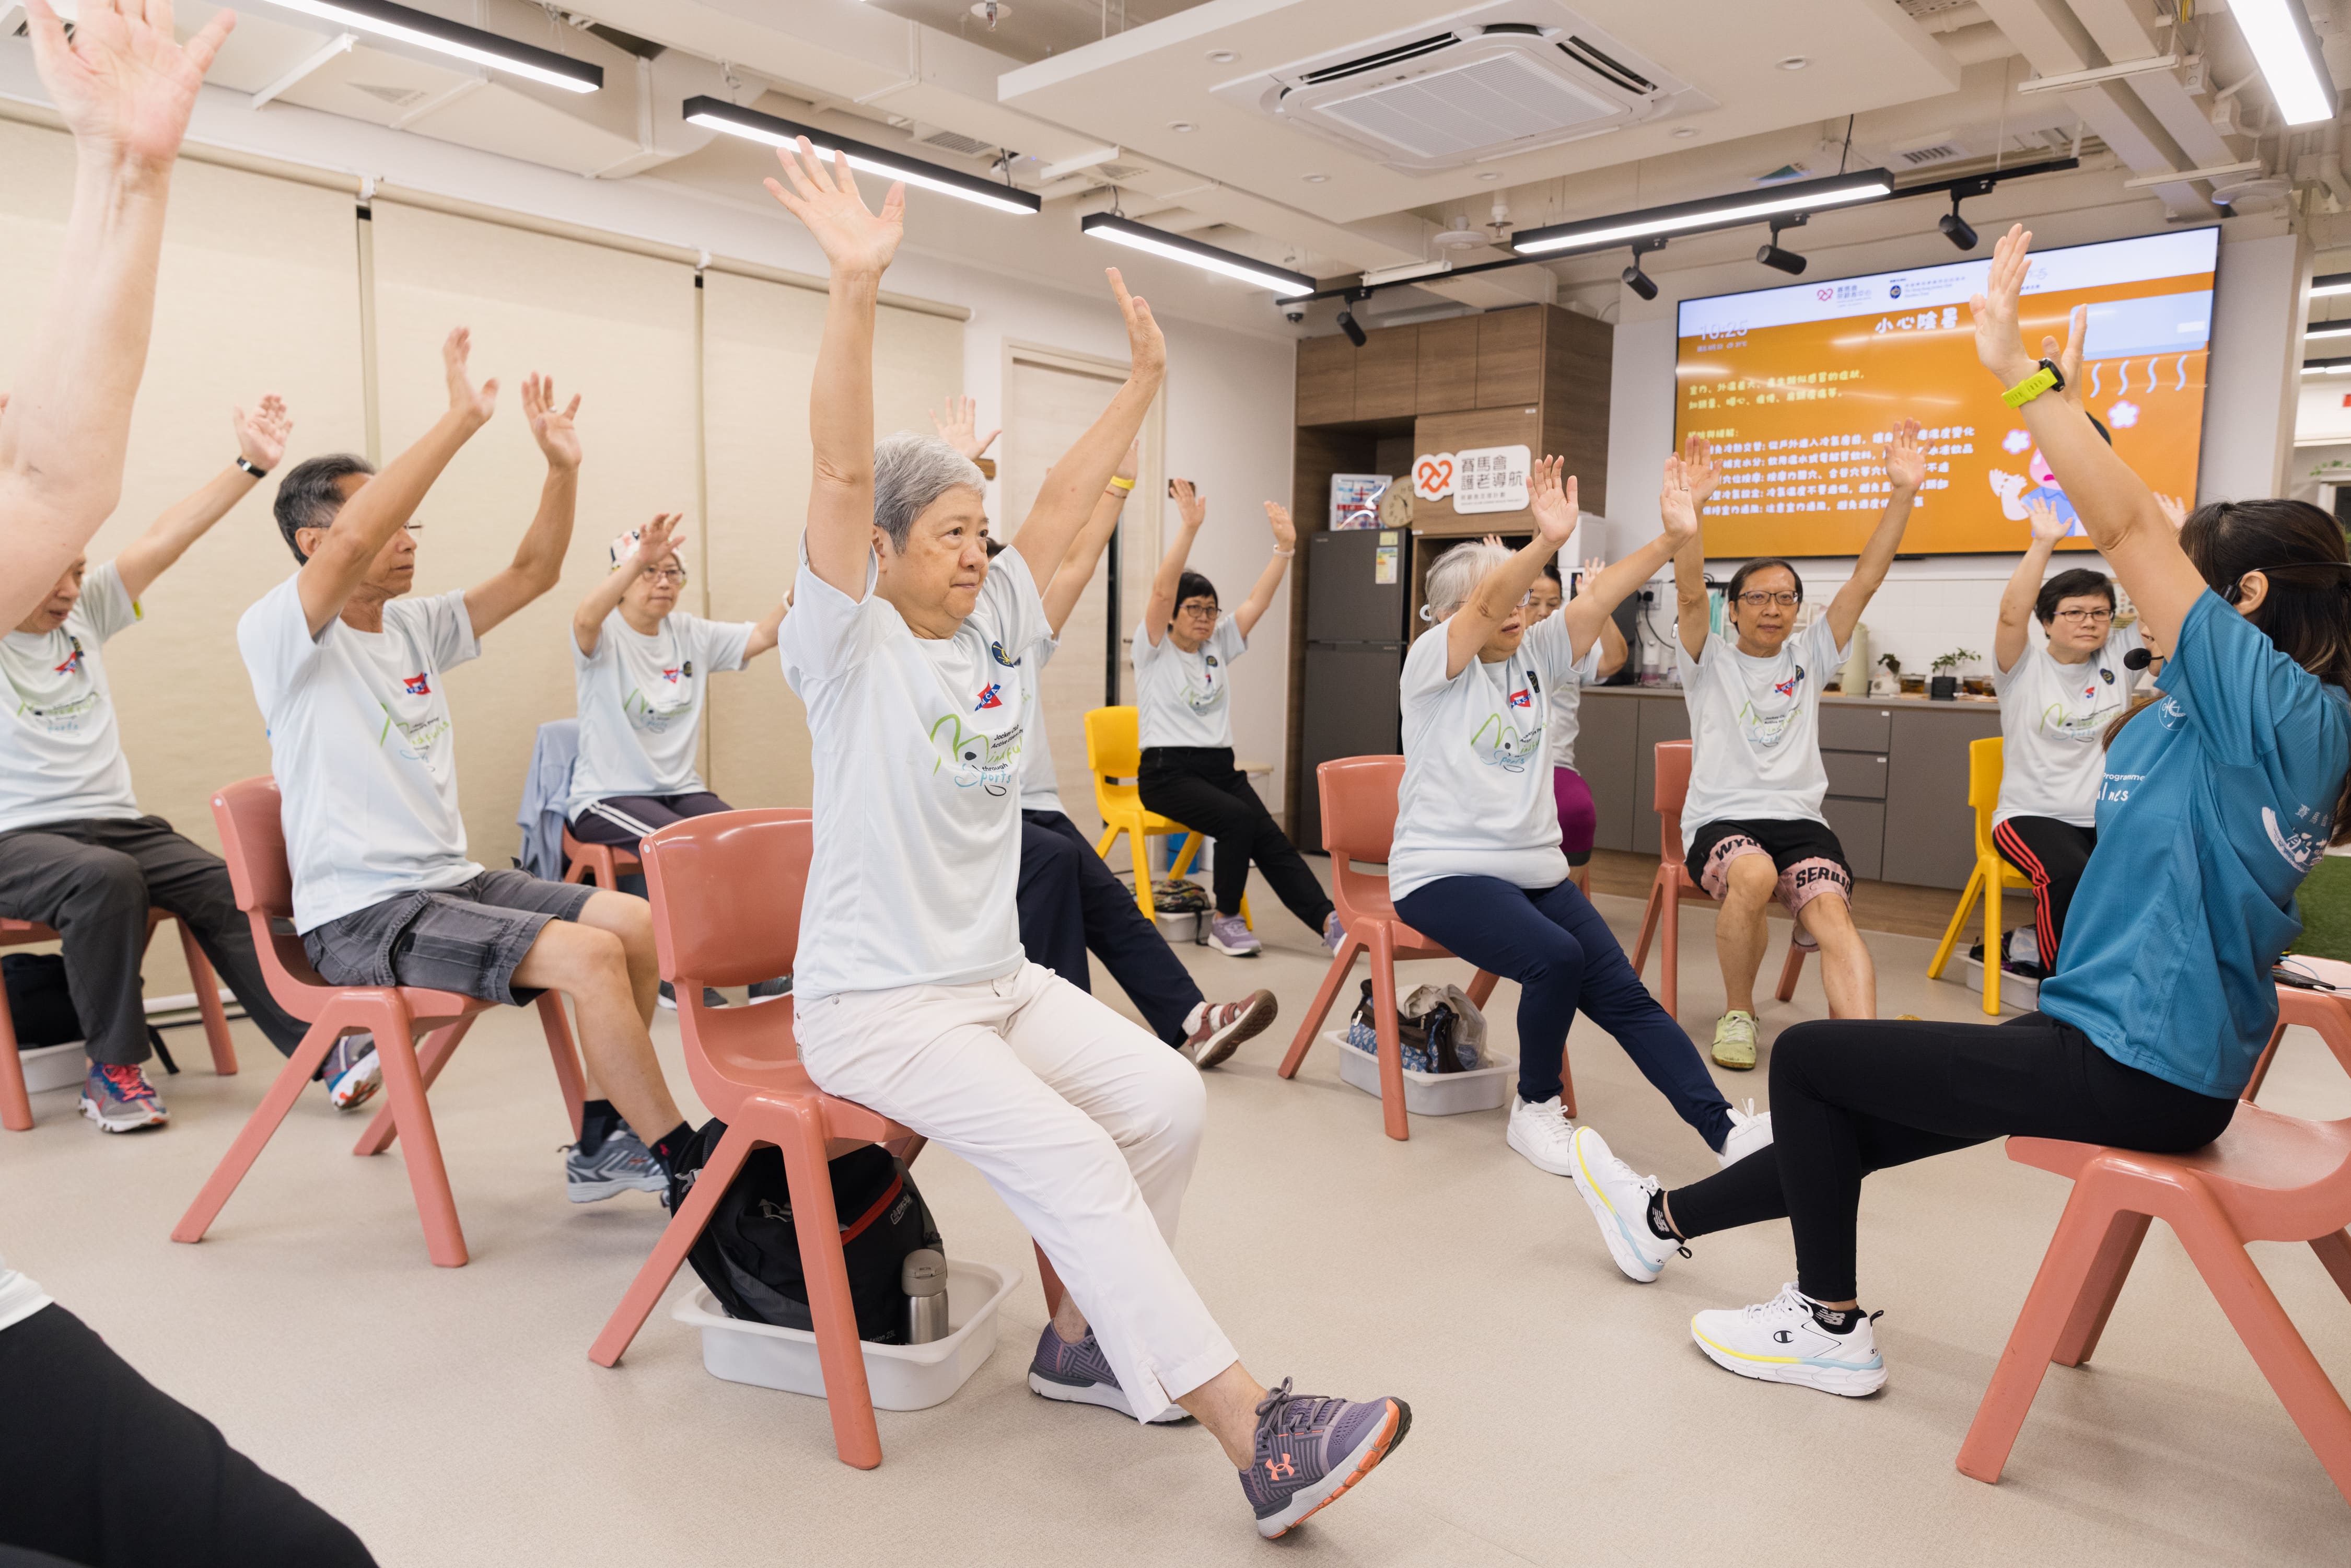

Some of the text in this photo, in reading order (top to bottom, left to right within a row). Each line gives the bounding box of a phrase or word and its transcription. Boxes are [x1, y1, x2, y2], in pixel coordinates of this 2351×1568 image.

[1462, 455, 1506, 473] 賽馬會
[1461, 471, 1523, 491] 護老導航
[982, 762, 1009, 772] through
